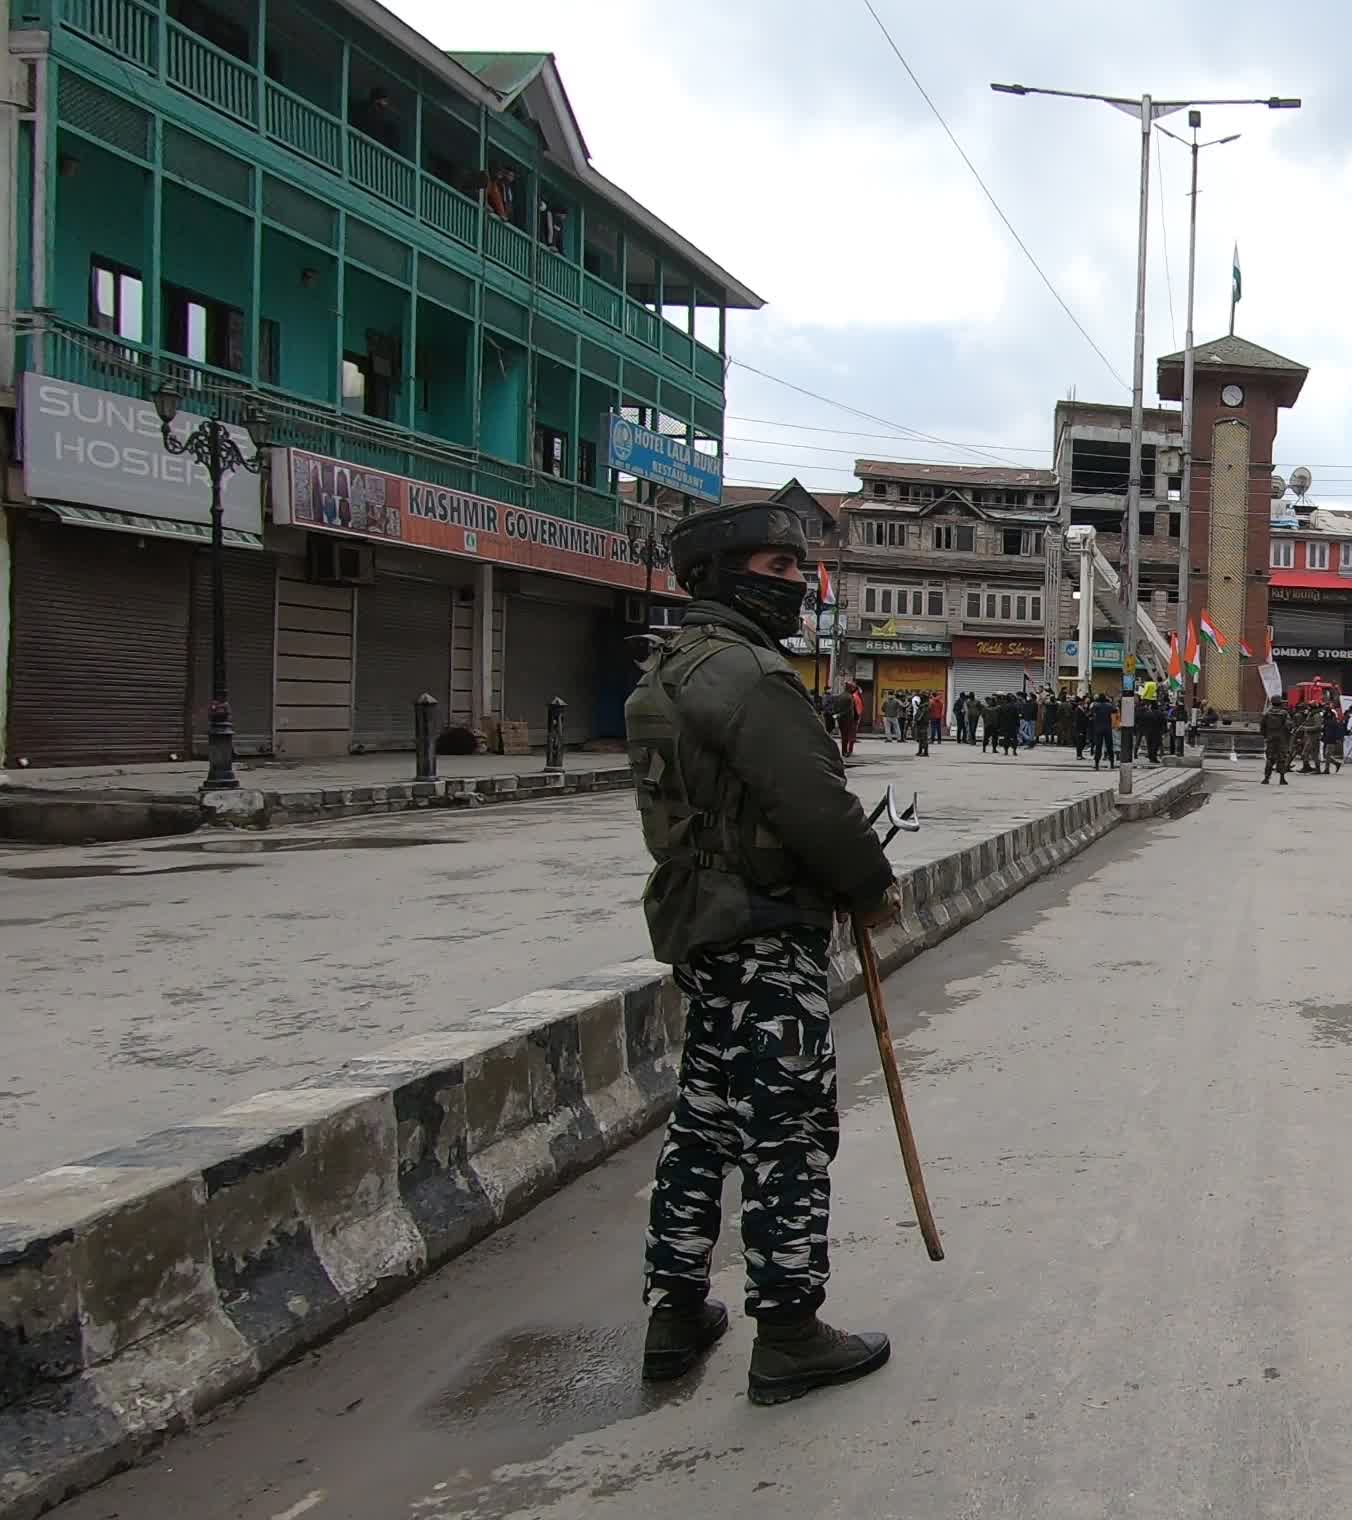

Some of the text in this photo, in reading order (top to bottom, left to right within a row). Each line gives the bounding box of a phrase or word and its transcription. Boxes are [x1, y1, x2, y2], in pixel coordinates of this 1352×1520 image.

[39, 386, 249, 448] SUNSHE
[634, 427, 665, 455] HOTEL
[667, 440, 691, 464] LALA
[652, 460, 705, 490] RESTAURANT
[409, 484, 498, 533] KASHMIR
[504, 509, 606, 558] GOVERNMENT
[1271, 647, 1312, 658] OMBAY
